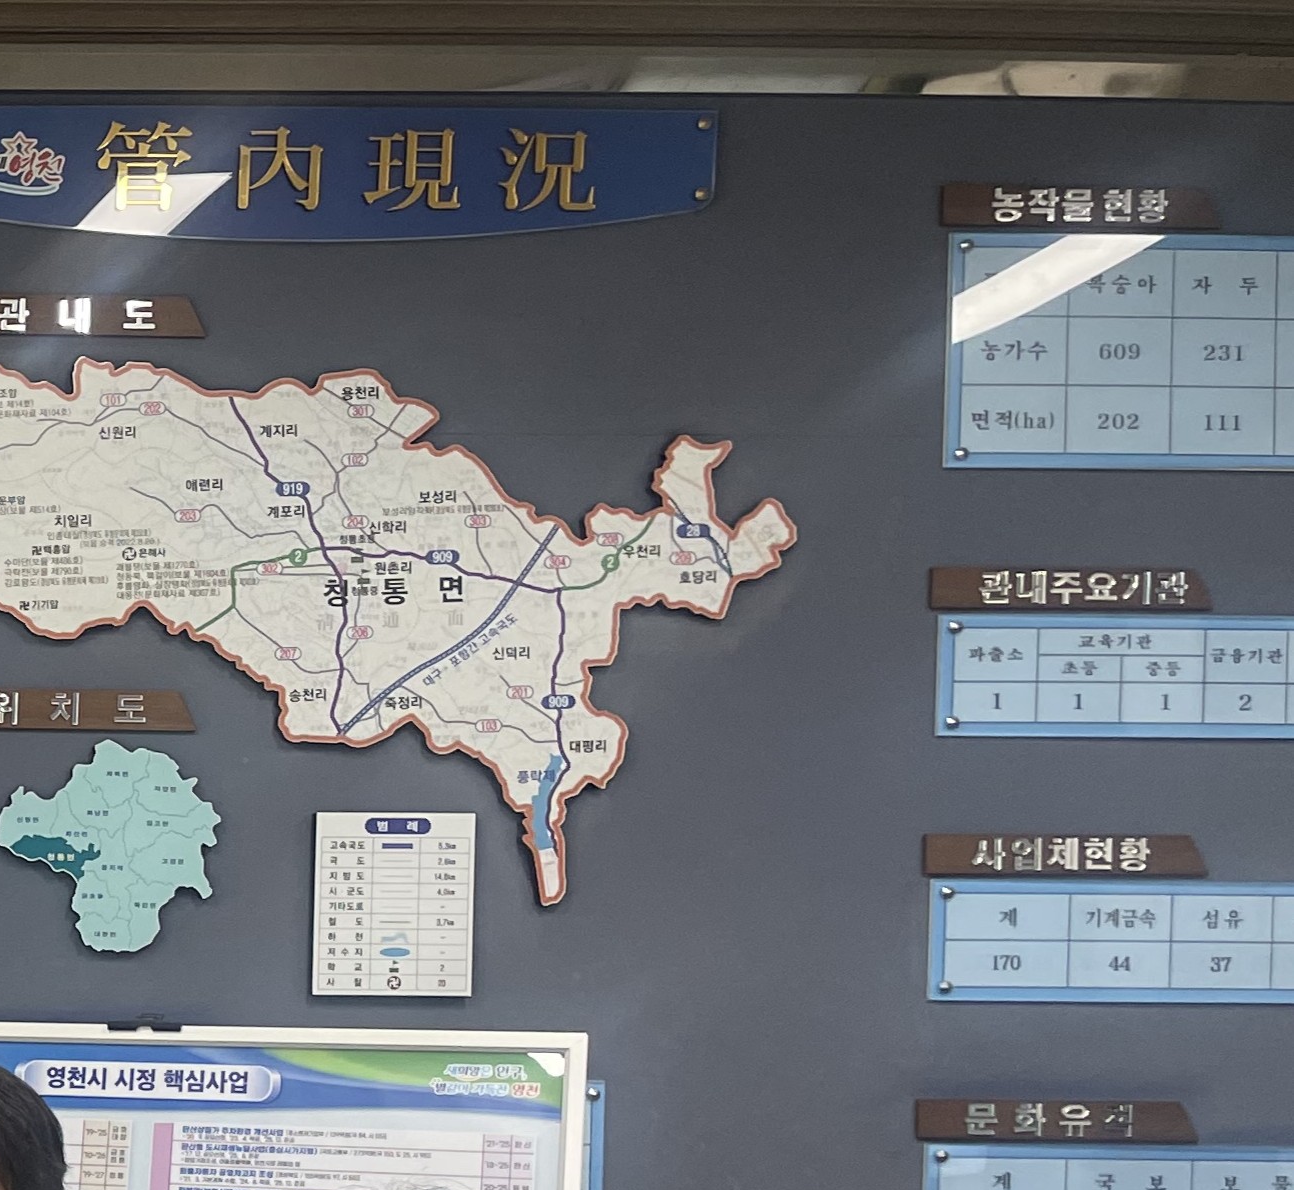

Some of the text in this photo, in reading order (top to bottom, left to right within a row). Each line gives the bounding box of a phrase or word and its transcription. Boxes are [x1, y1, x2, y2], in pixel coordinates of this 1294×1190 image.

[980, 340, 1049, 361] 농가수
[1098, 343, 1142, 361] 609
[1202, 344, 1244, 362] 231
[341, 386, 380, 400] 용천리
[352, 406, 369, 417] 301
[1097, 413, 1141, 430] 202
[1203, 414, 1242, 431] 111
[98, 426, 137, 439] 신원리
[260, 424, 298, 438] 계지리
[282, 483, 304, 496] 919
[419, 490, 457, 504] 보성리
[267, 505, 306, 518] 계포리
[54, 514, 92, 527] 치일리
[369, 520, 407, 534] 신학리
[432, 551, 453, 563] 909
[623, 545, 661, 558] 우천리
[374, 561, 413, 575] 원촌리
[1077, 635, 1153, 650] 교육기관
[492, 646, 531, 660] 신덕리
[968, 646, 1024, 662] 파출소
[288, 688, 327, 702] 승천리
[549, 696, 569, 708] 909
[991, 693, 1002, 711] 1
[1073, 693, 1083, 711] 1
[1161, 694, 1171, 711] 1
[383, 696, 423, 710] 죽정리
[1238, 694, 1253, 712] 2
[569, 739, 607, 754] 대평리
[998, 908, 1018, 927] 계
[1085, 909, 1157, 929] 기계금속
[992, 955, 1022, 971] 170
[1108, 956, 1131, 972] 44
[1210, 956, 1232, 973] 37
[46, 1066, 250, 1095] 영천시 시정 핵심사업
[992, 1172, 1012, 1190] 계
